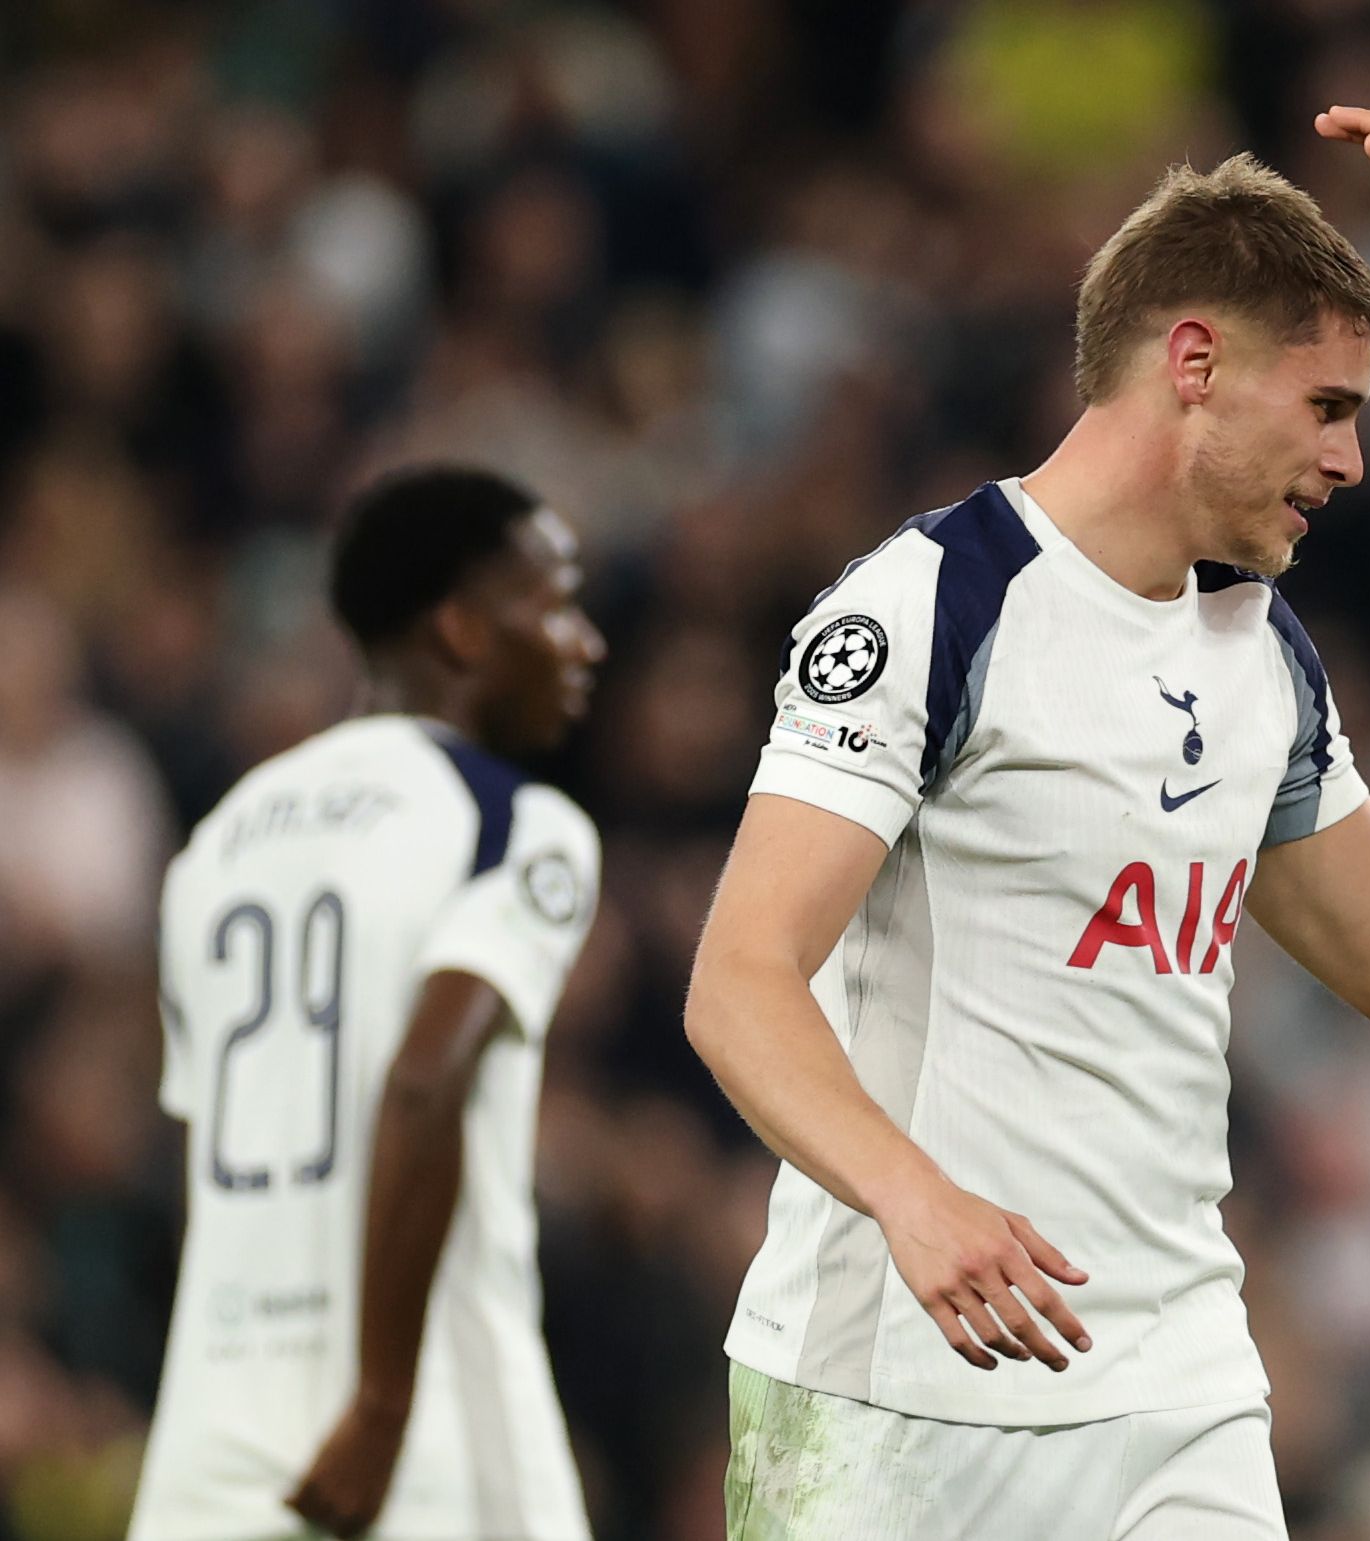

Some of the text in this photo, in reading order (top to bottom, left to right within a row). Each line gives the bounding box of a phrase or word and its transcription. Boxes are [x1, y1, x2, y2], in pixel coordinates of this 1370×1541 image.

[821, 616, 887, 647] UEFA EUROPA LEAGUE
[804, 683, 852, 702] 2025 WINNERS
[777, 714, 836, 740] FOUNDATION
[837, 725, 869, 753] 10
[1066, 858, 1248, 975] AIA
[211, 890, 345, 1191] 29
